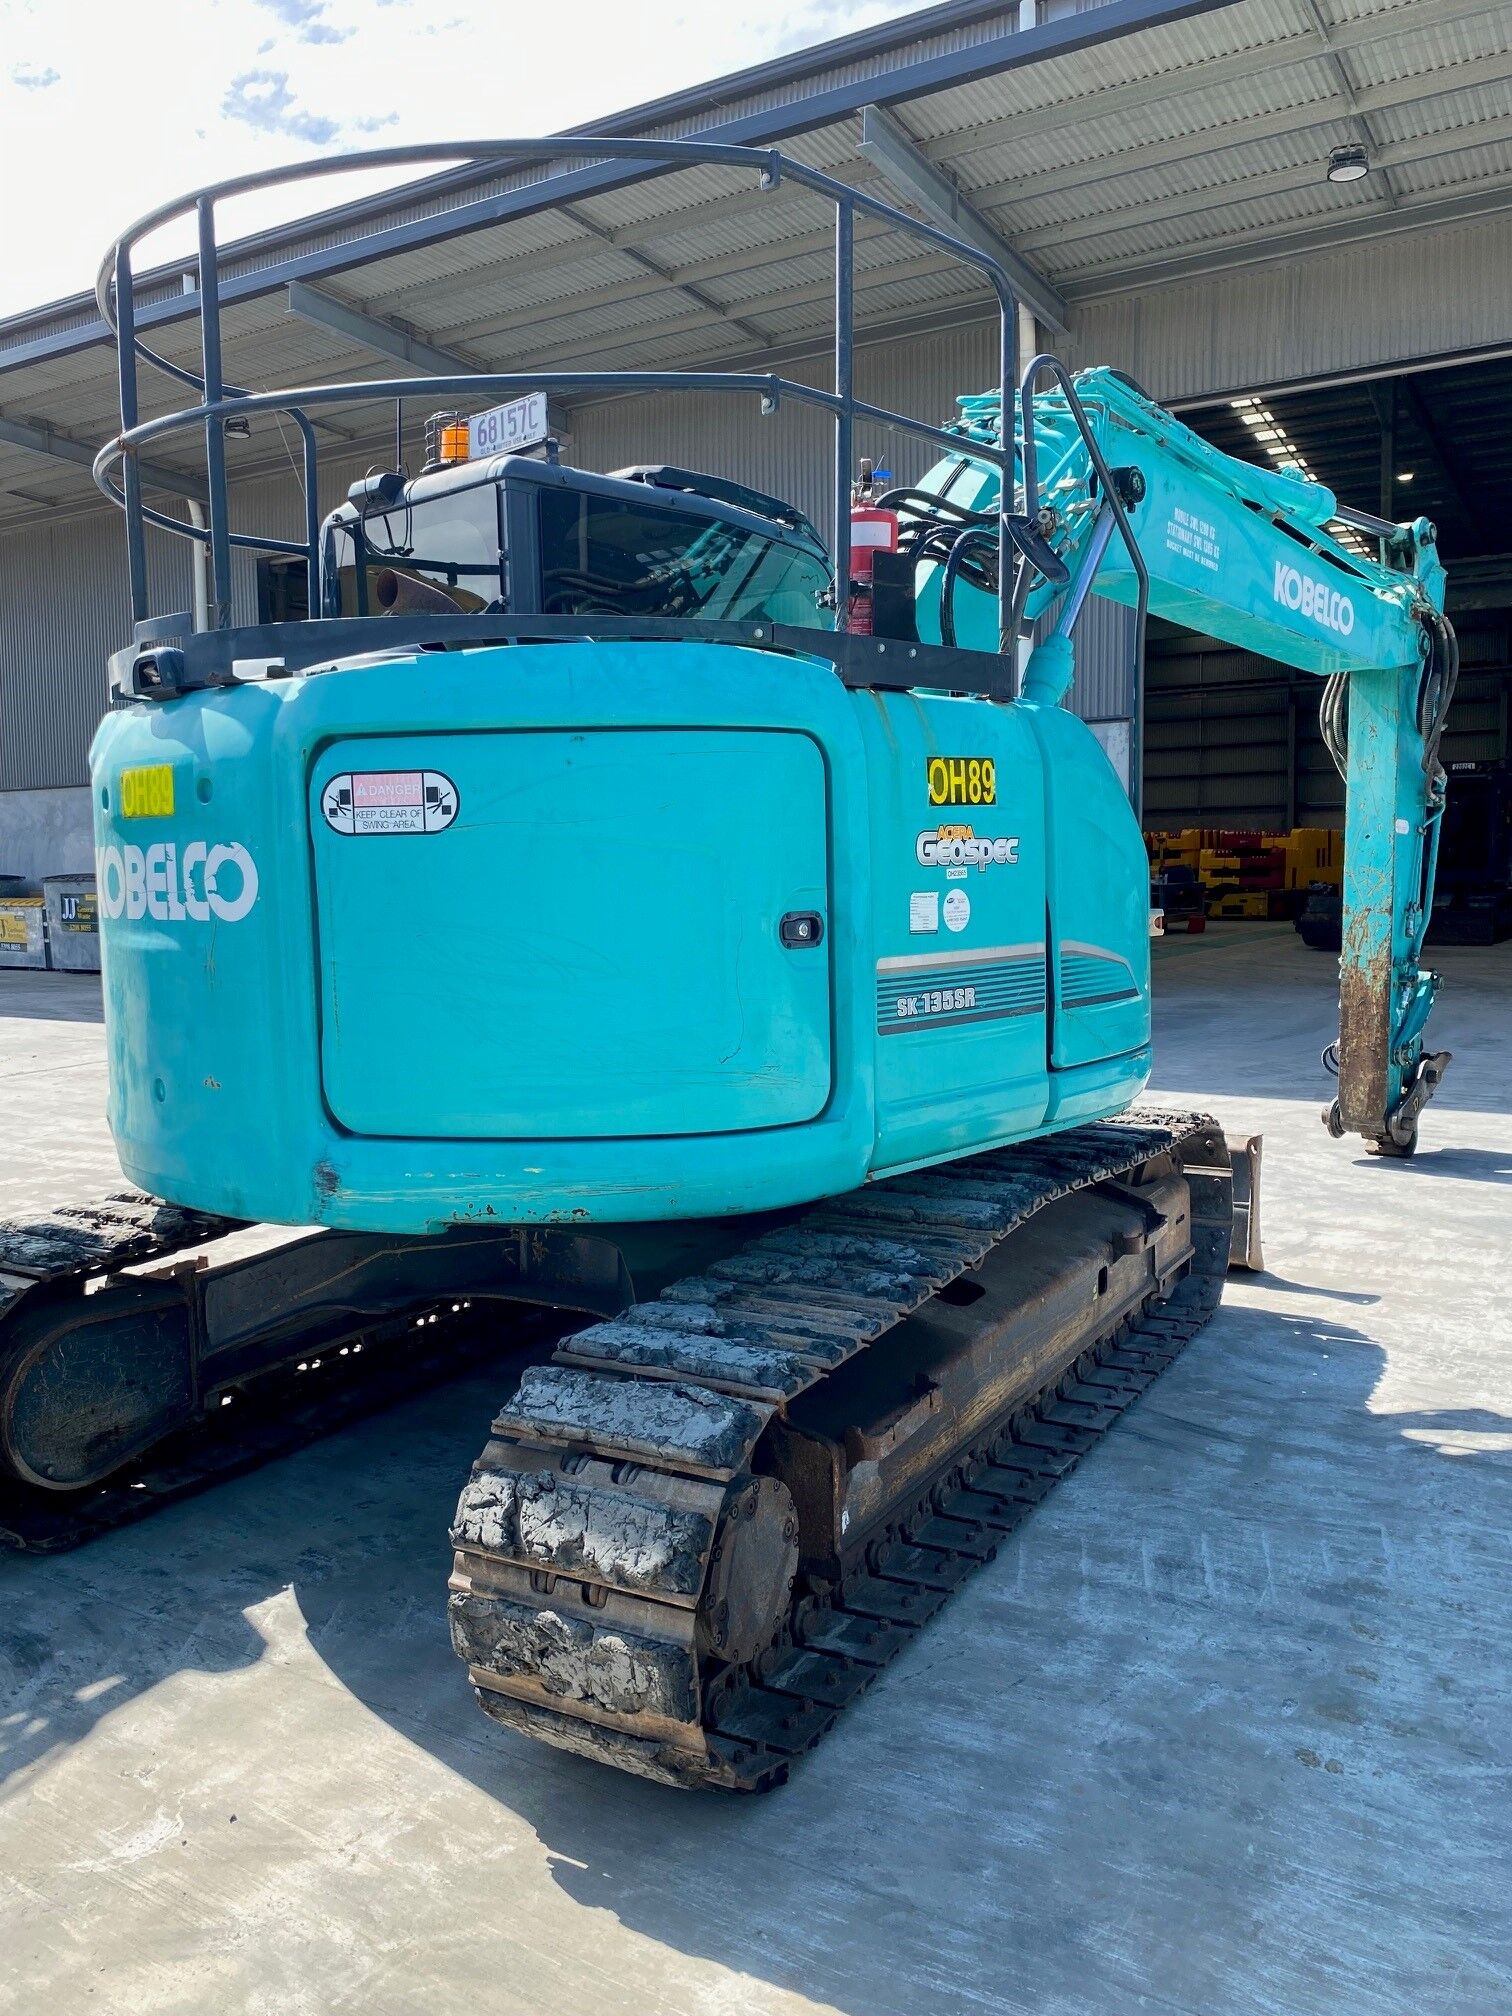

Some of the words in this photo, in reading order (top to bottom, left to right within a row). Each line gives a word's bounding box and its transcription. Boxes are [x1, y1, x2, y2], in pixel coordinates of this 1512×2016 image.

[477, 399, 538, 447] 68157C
[1273, 560, 1355, 636] KOBELCO
[369, 784, 421, 796] DANGER
[929, 759, 995, 804] OH89
[356, 810, 377, 819] KEEP
[380, 810, 407, 818] CLEAR
[410, 809, 422, 817] OF
[362, 821, 389, 830] SWING
[393, 820, 416, 829] AREA
[897, 996, 918, 1017] SK
[920, 987, 976, 1014] 135SR
